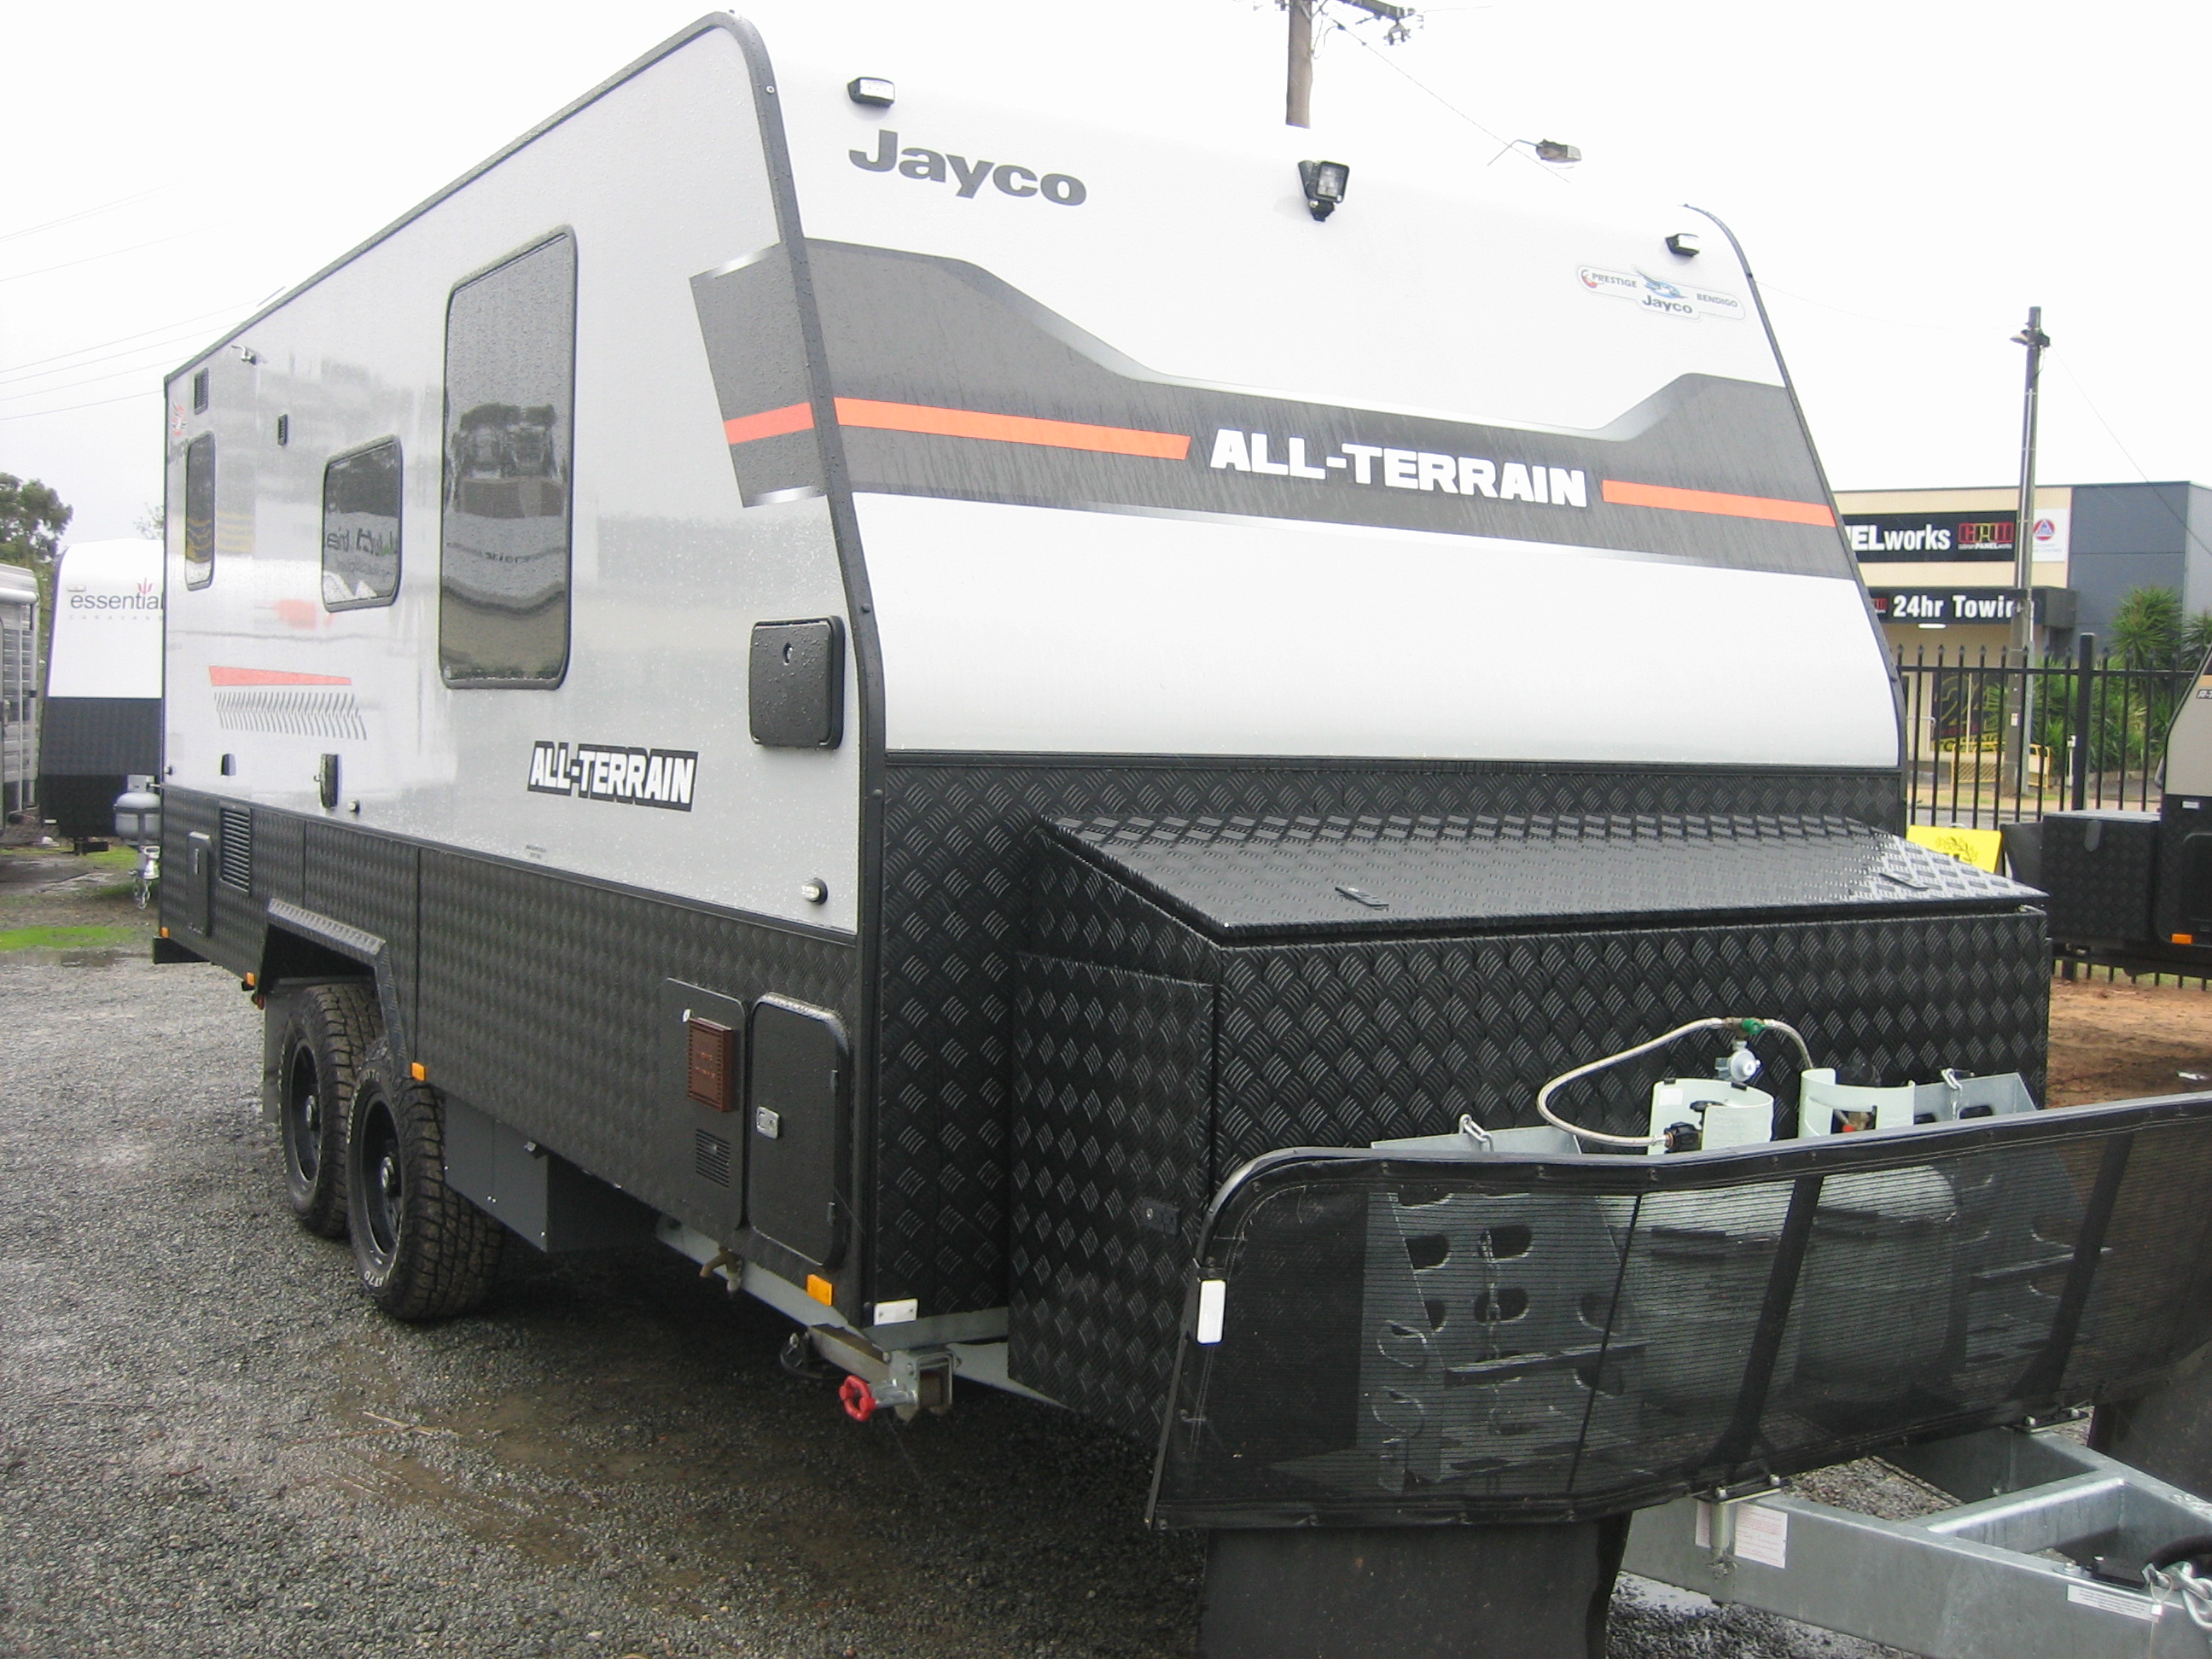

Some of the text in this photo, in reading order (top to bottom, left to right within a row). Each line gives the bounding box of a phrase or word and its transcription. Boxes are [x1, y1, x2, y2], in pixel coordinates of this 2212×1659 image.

[849, 129, 1086, 206] Jayco
[1592, 272, 1738, 308] PRESTIGE BENDIGO
[1642, 295, 1693, 314] Jayco
[1210, 428, 1588, 508] ALL-TERRAIN
[1845, 523, 1951, 551] ELworks
[1893, 594, 1945, 619] 24hr
[1953, 594, 2035, 619] Towi
[528, 745, 696, 806] ALL-TERRAIN
